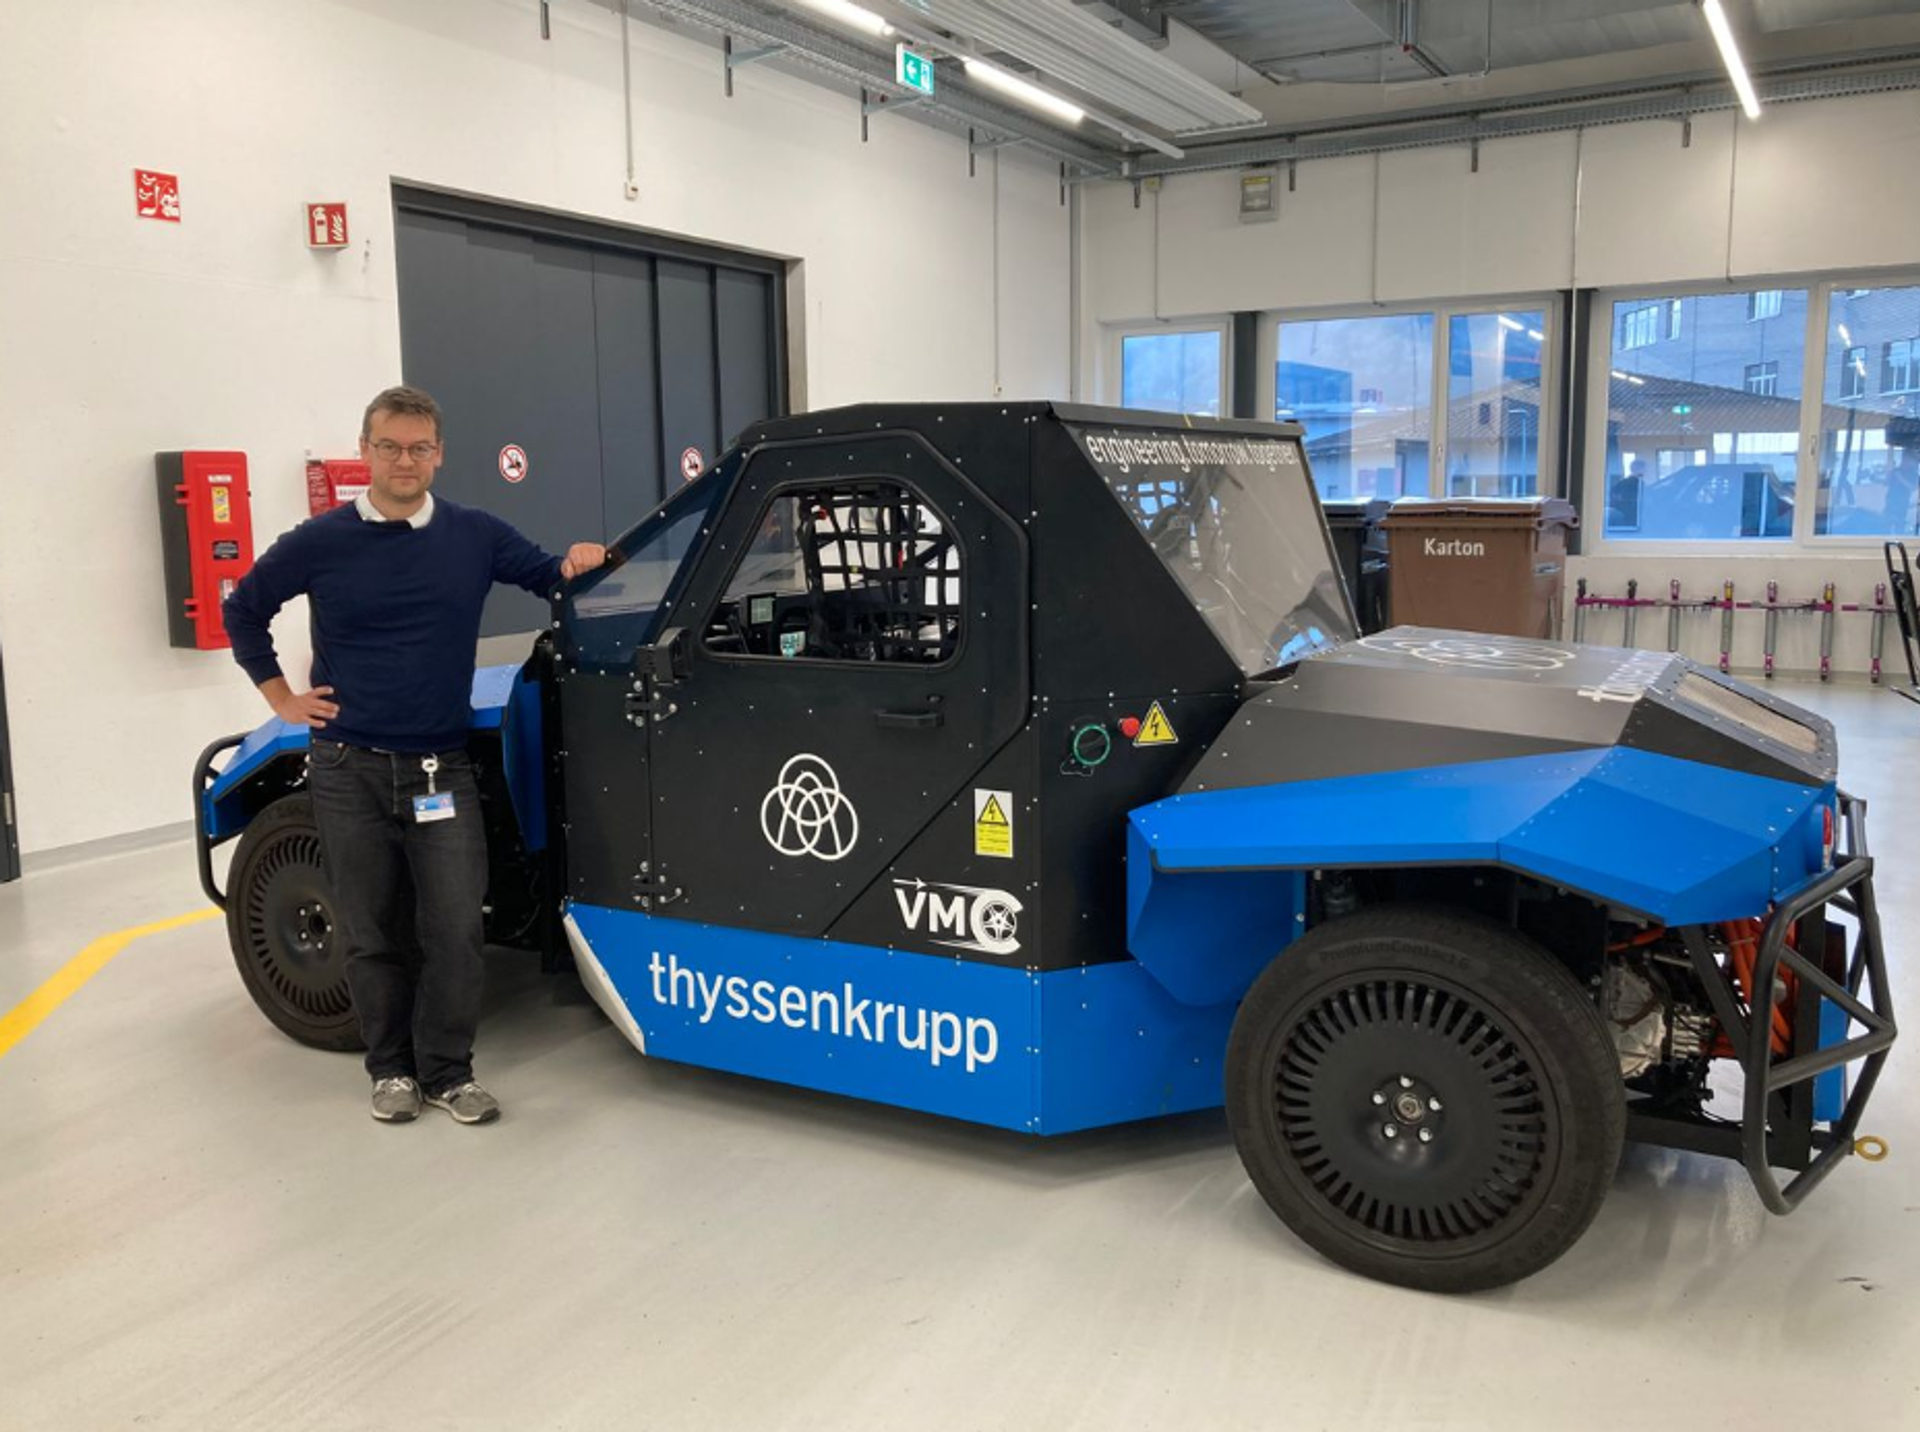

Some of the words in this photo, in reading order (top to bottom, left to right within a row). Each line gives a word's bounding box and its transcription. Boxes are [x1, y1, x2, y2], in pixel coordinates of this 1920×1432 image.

[1424, 538, 1485, 556] Karton
[894, 887, 1023, 955] VMC
[649, 952, 999, 1073] thyssenkrupp
